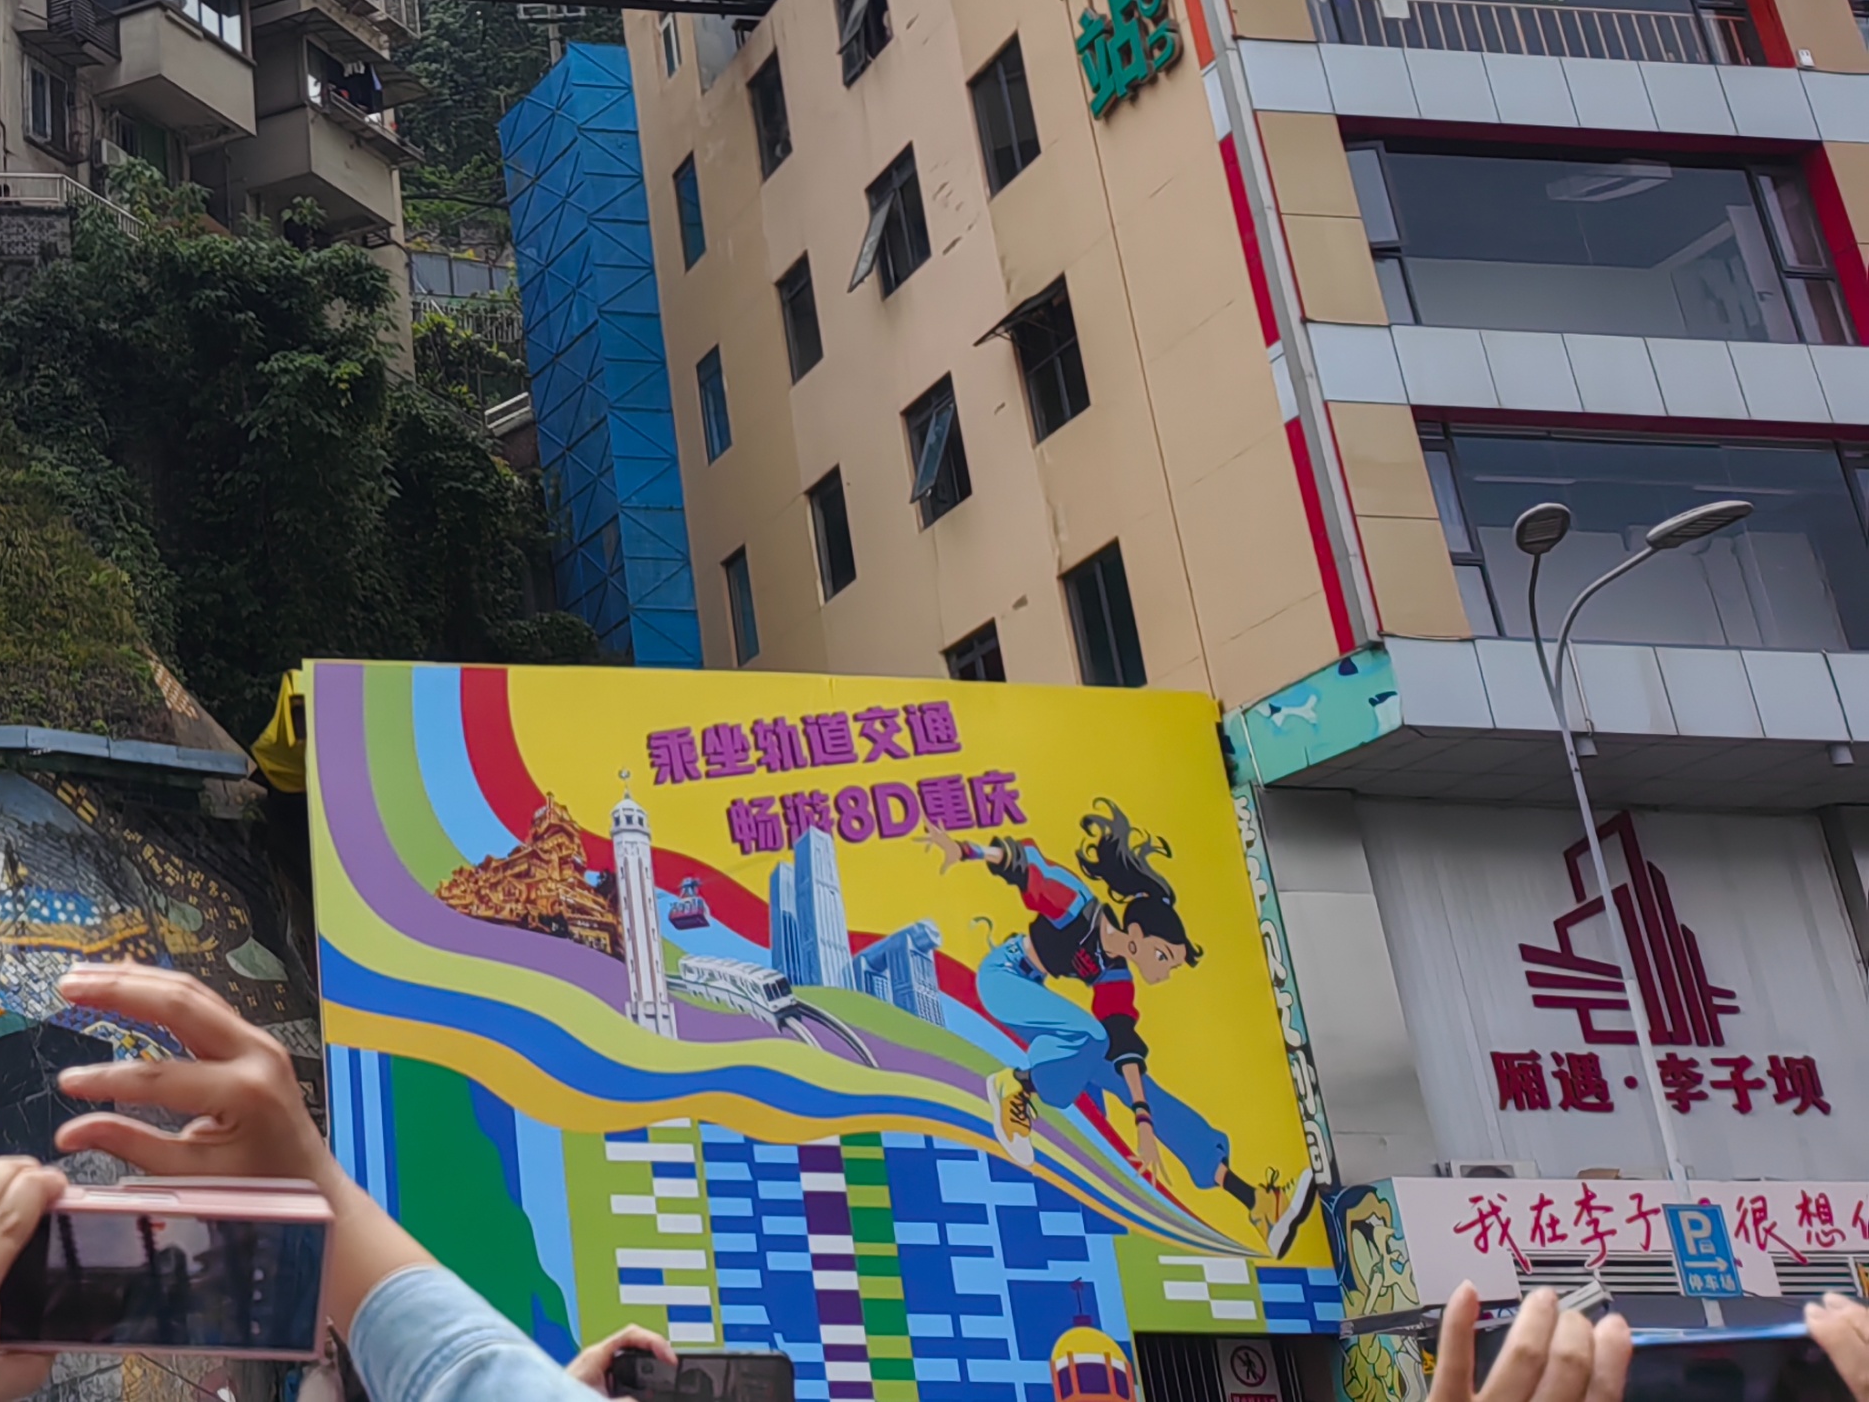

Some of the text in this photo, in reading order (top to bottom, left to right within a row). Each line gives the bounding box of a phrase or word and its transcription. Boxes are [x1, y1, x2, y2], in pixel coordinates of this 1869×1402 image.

[647, 700, 961, 785] 乘坐轨道交通
[727, 770, 1027, 855] 畅游8D重庆
[1453, 1182, 1869, 1274] 我在李子很想
[1678, 1210, 1712, 1255] P
[1688, 1272, 1736, 1293] 停车场
